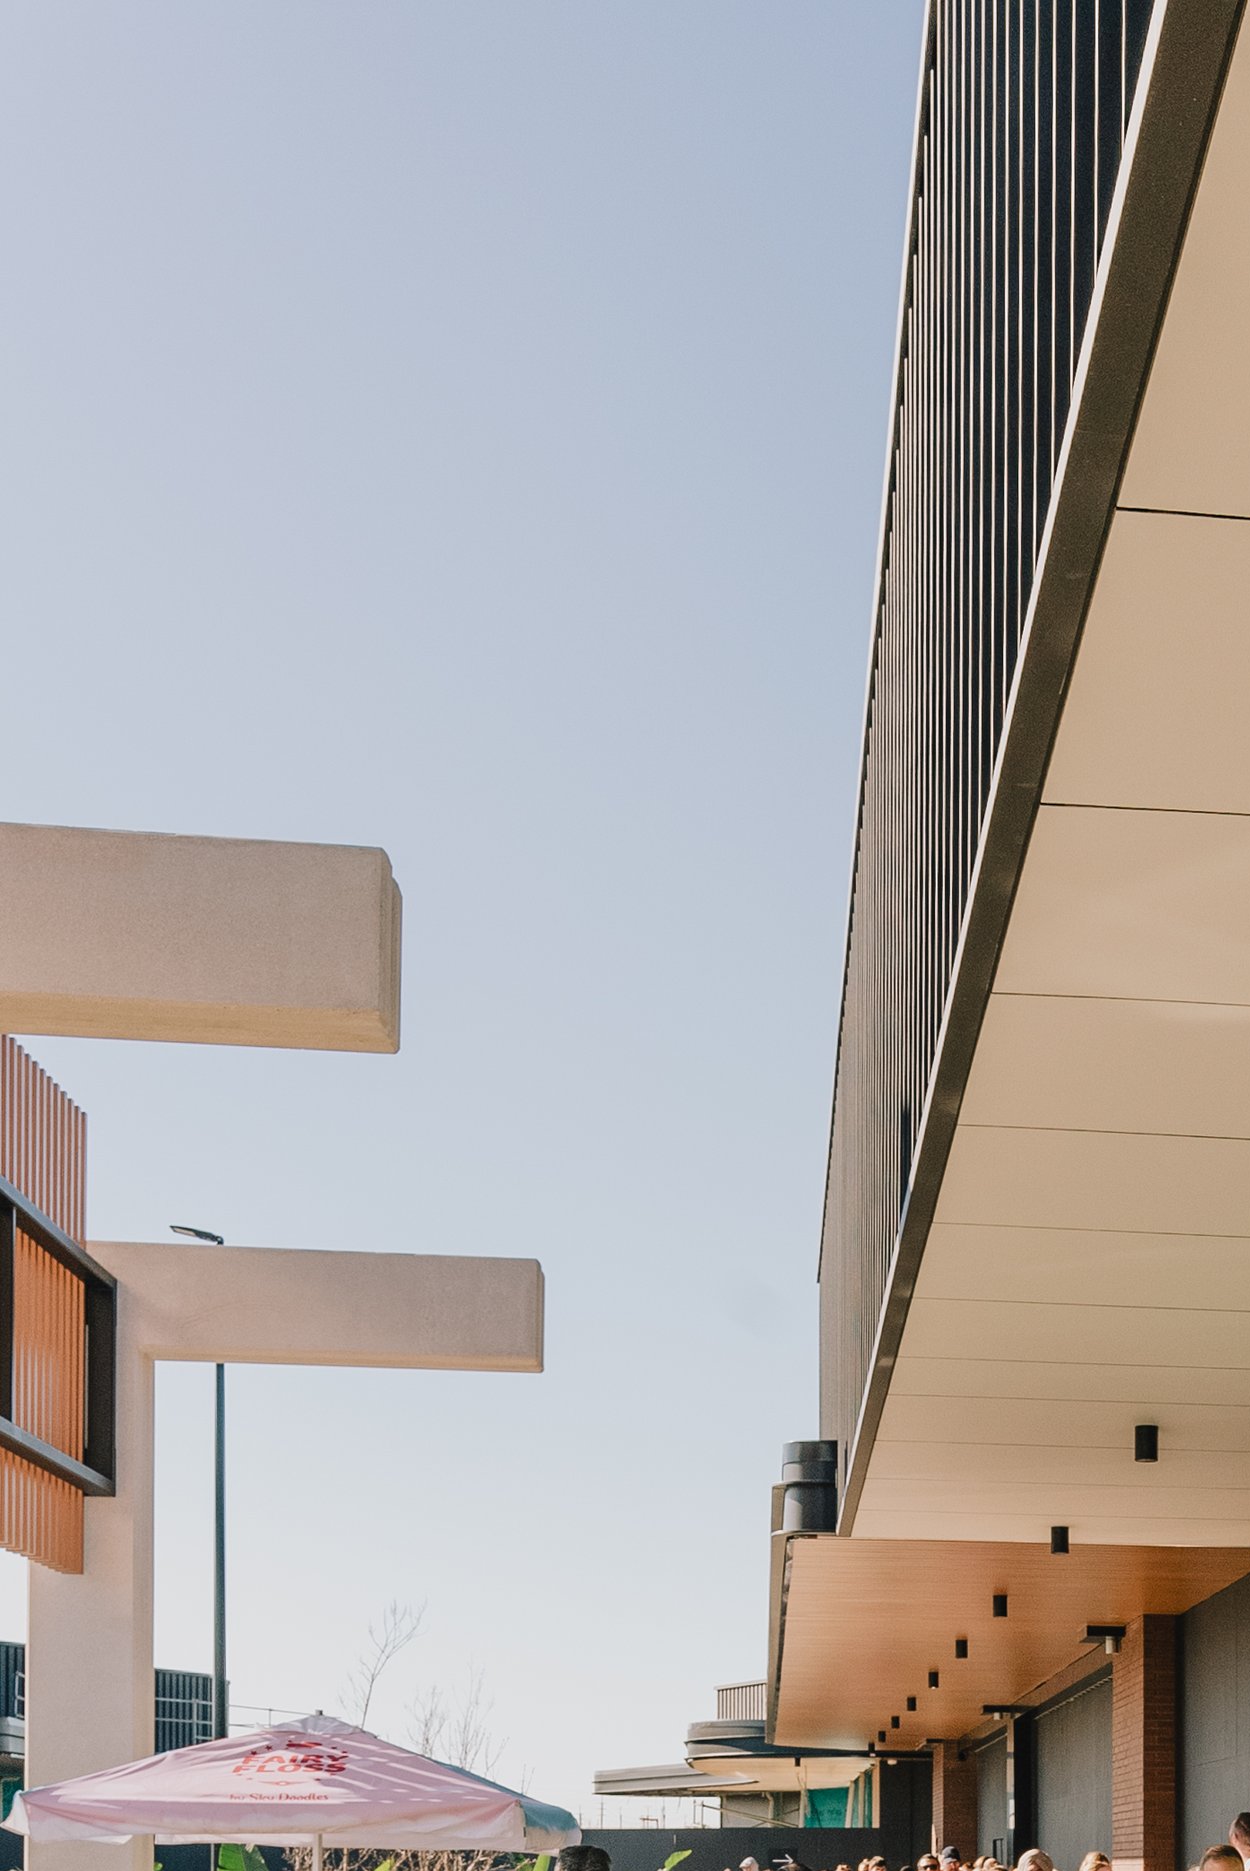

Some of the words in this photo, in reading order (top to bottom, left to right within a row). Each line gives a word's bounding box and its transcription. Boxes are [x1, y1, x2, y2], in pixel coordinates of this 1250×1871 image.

[242, 1754, 348, 1765] FAIRY
[232, 1763, 347, 1773] FLOSS
[279, 1792, 329, 1801] Doodles
